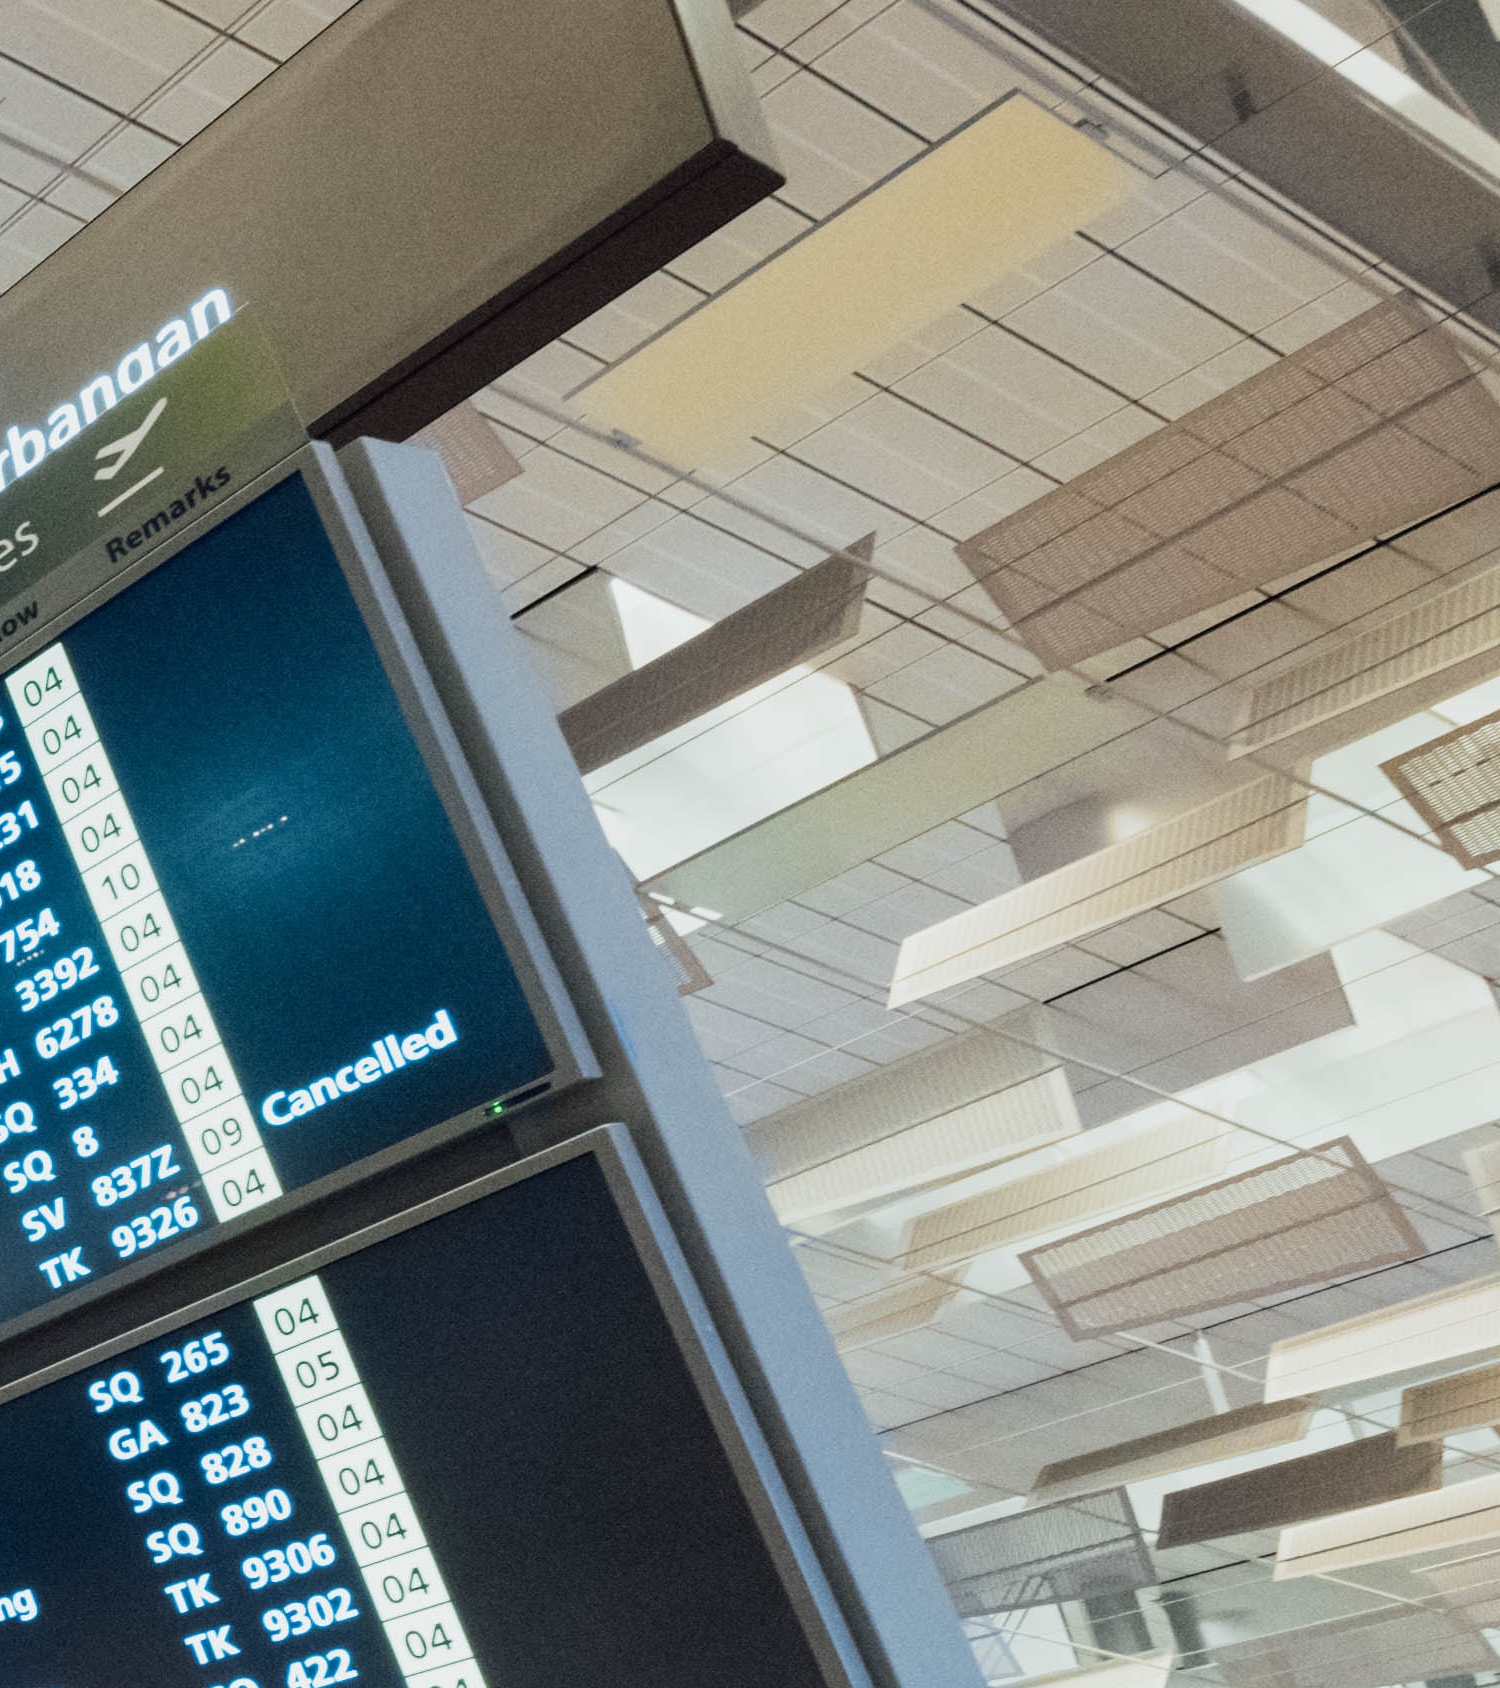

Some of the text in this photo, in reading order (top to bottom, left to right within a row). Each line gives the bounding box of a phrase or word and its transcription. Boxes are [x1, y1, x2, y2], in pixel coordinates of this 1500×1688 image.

[105, 466, 231, 563] Remarks
[23, 665, 63, 708] 04
[42, 714, 82, 756] 04
[61, 763, 102, 805] 04
[3, 1150, 56, 1194] SQ
[72, 1126, 99, 1158] 8
[180, 1065, 224, 1105] 04
[22, 1197, 65, 1242] SV
[91, 1144, 181, 1207] 837Z
[200, 1117, 243, 1156] 09
[262, 1009, 458, 1126] Cancelled
[89, 1371, 143, 1413] SQ
[160, 1331, 229, 1383] 265
[273, 1297, 319, 1337] 04
[109, 1419, 169, 1460] GA
[180, 1384, 250, 1433] 823
[295, 1350, 341, 1389] 05
